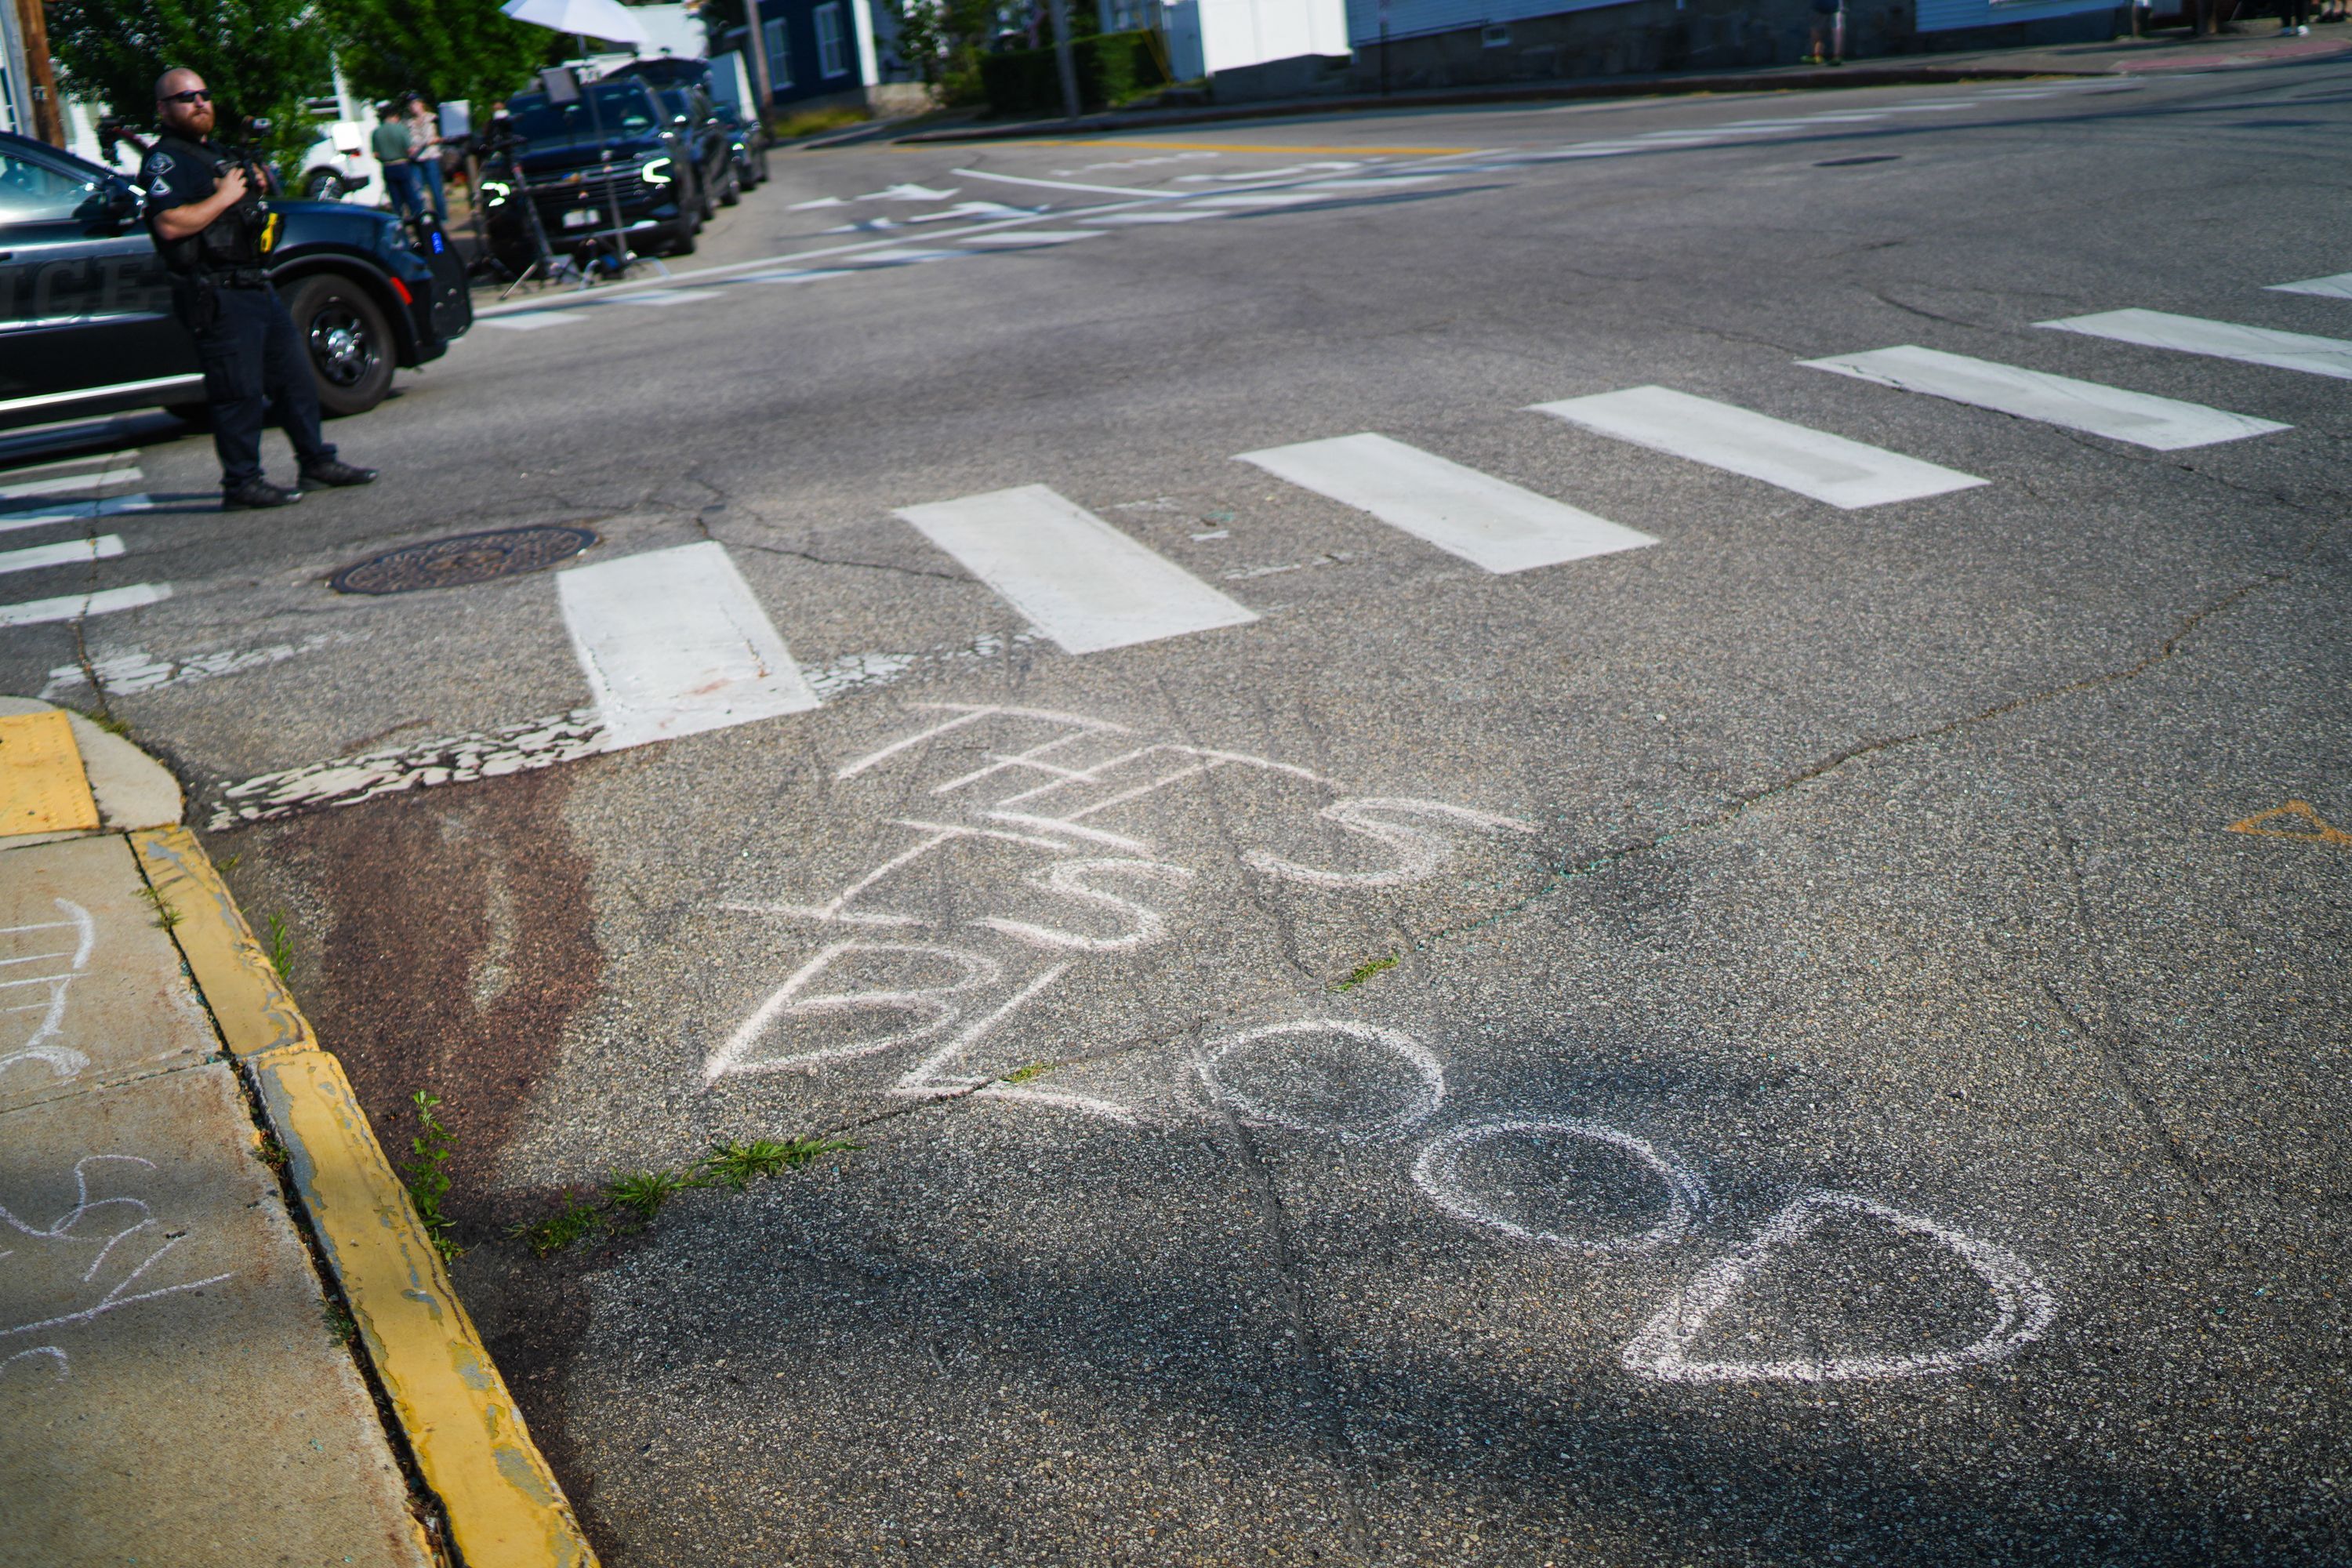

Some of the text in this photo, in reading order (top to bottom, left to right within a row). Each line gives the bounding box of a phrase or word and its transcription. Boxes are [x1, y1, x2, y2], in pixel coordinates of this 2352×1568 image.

[717, 817, 1197, 952] IS
[836, 700, 1541, 889] THIS
[703, 940, 2057, 1384] BLOOD
